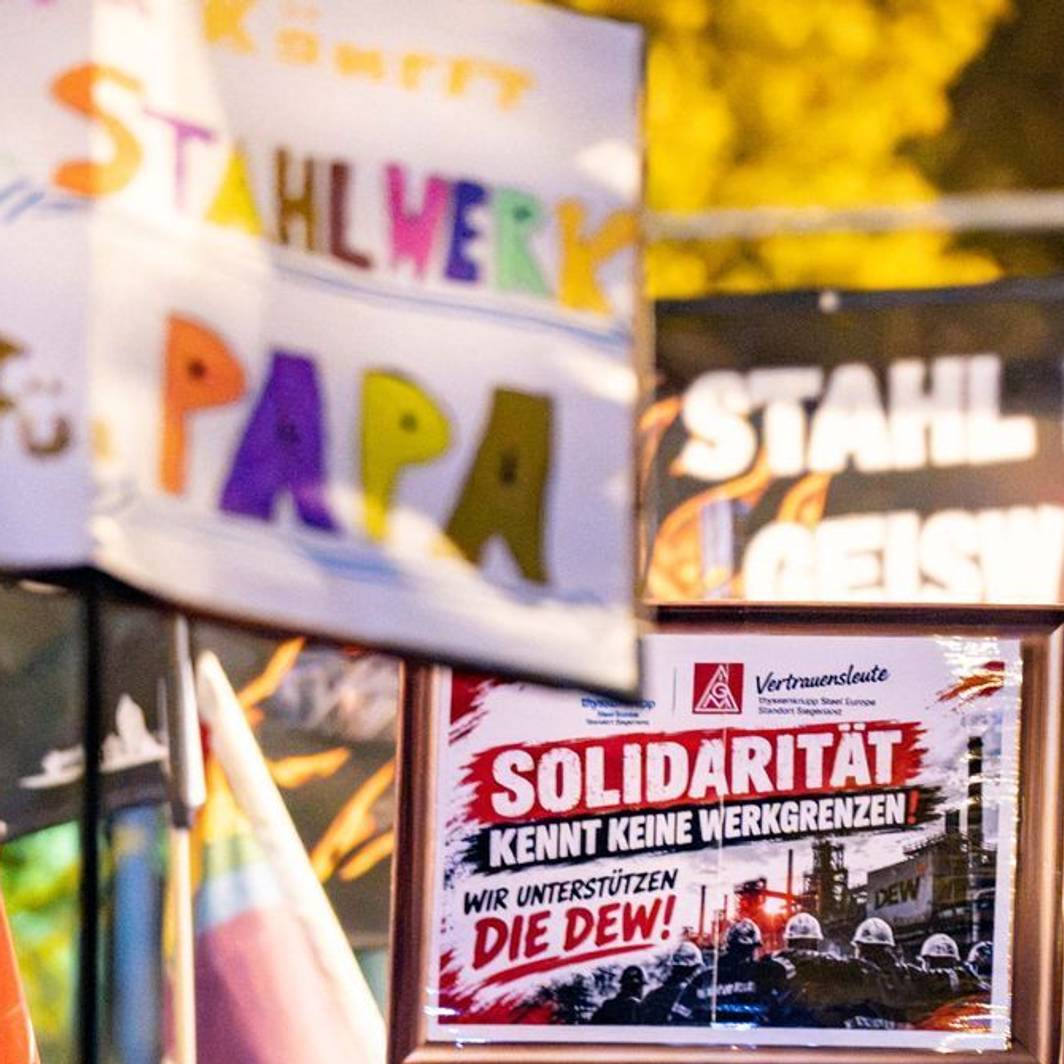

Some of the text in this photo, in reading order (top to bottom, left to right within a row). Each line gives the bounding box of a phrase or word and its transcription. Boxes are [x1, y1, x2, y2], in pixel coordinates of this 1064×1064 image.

[50, 63, 637, 316] STAHLWERK
[156, 313, 556, 588] PAPA
[681, 352, 1037, 481] STAHL
[756, 664, 890, 695] Vertrauensleute
[490, 723, 902, 818] SOLIDARITÄT
[488, 789, 919, 869] KENNT KEINE WERKGRENZEN!
[463, 868, 679, 915] WIR UNTERSTÜTZEN
[874, 876, 920, 911] DEW
[472, 894, 677, 970] DIE DEW!
